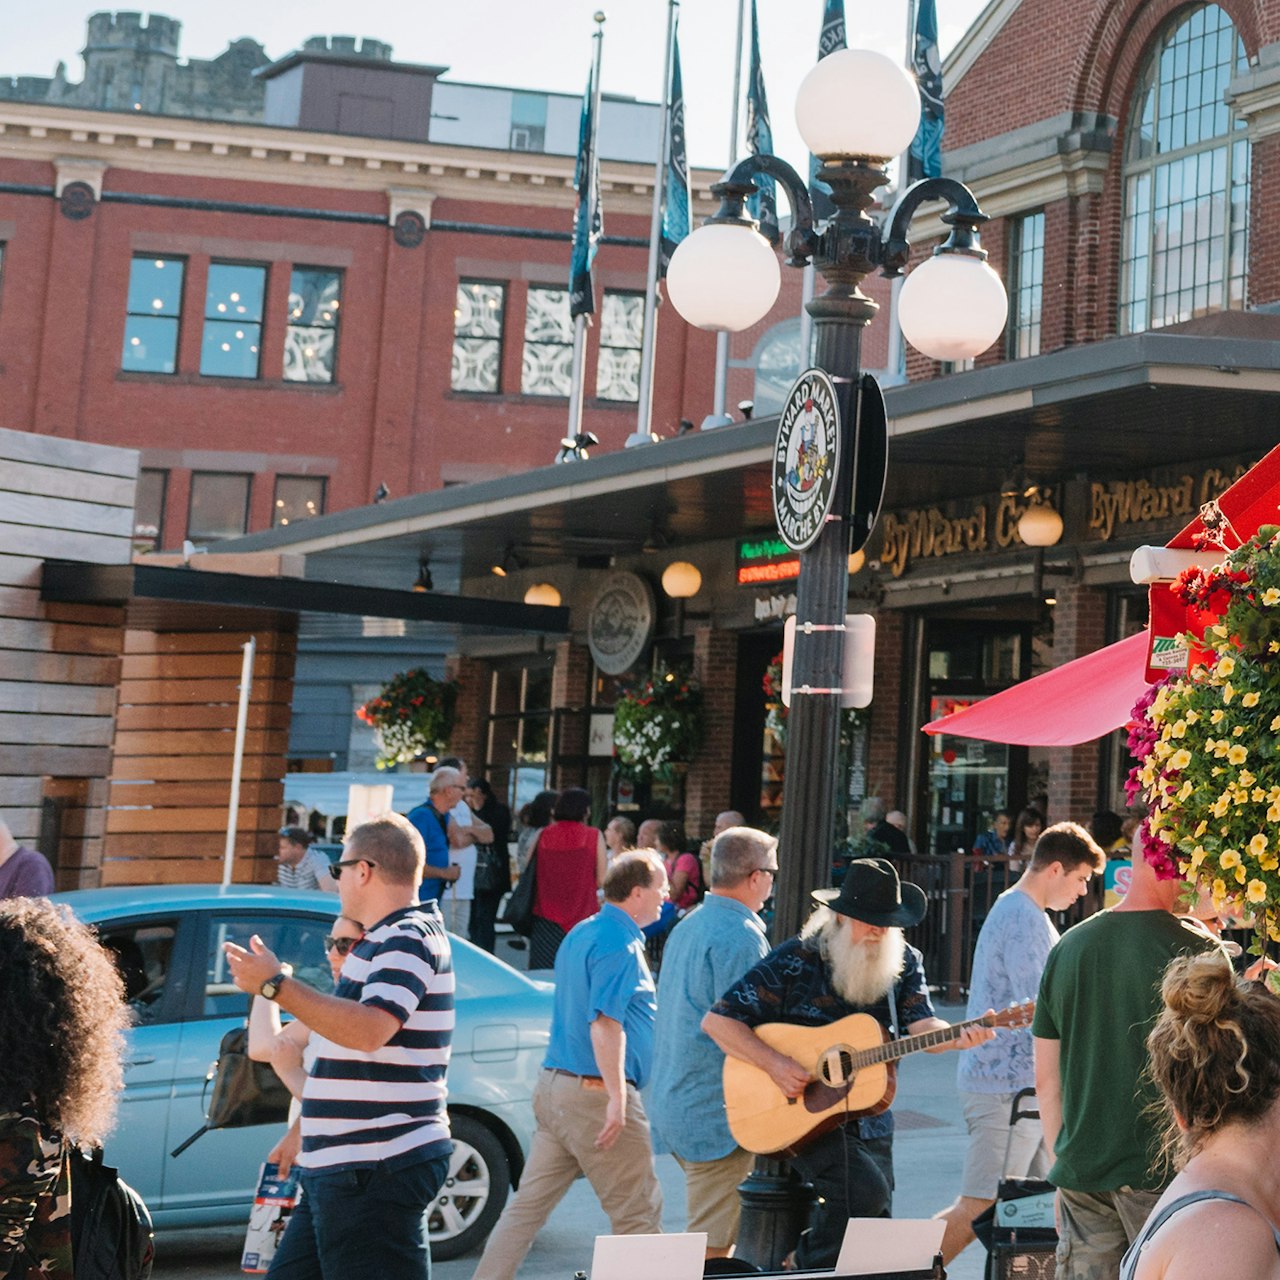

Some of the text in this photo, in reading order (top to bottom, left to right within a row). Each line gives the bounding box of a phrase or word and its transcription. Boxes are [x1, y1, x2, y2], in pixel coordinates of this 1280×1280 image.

[810, 381, 836, 454] MARKET
[812, 491, 825, 525] BY
[880, 505, 987, 578] ByWard
[1090, 475, 1194, 542] ByWard
